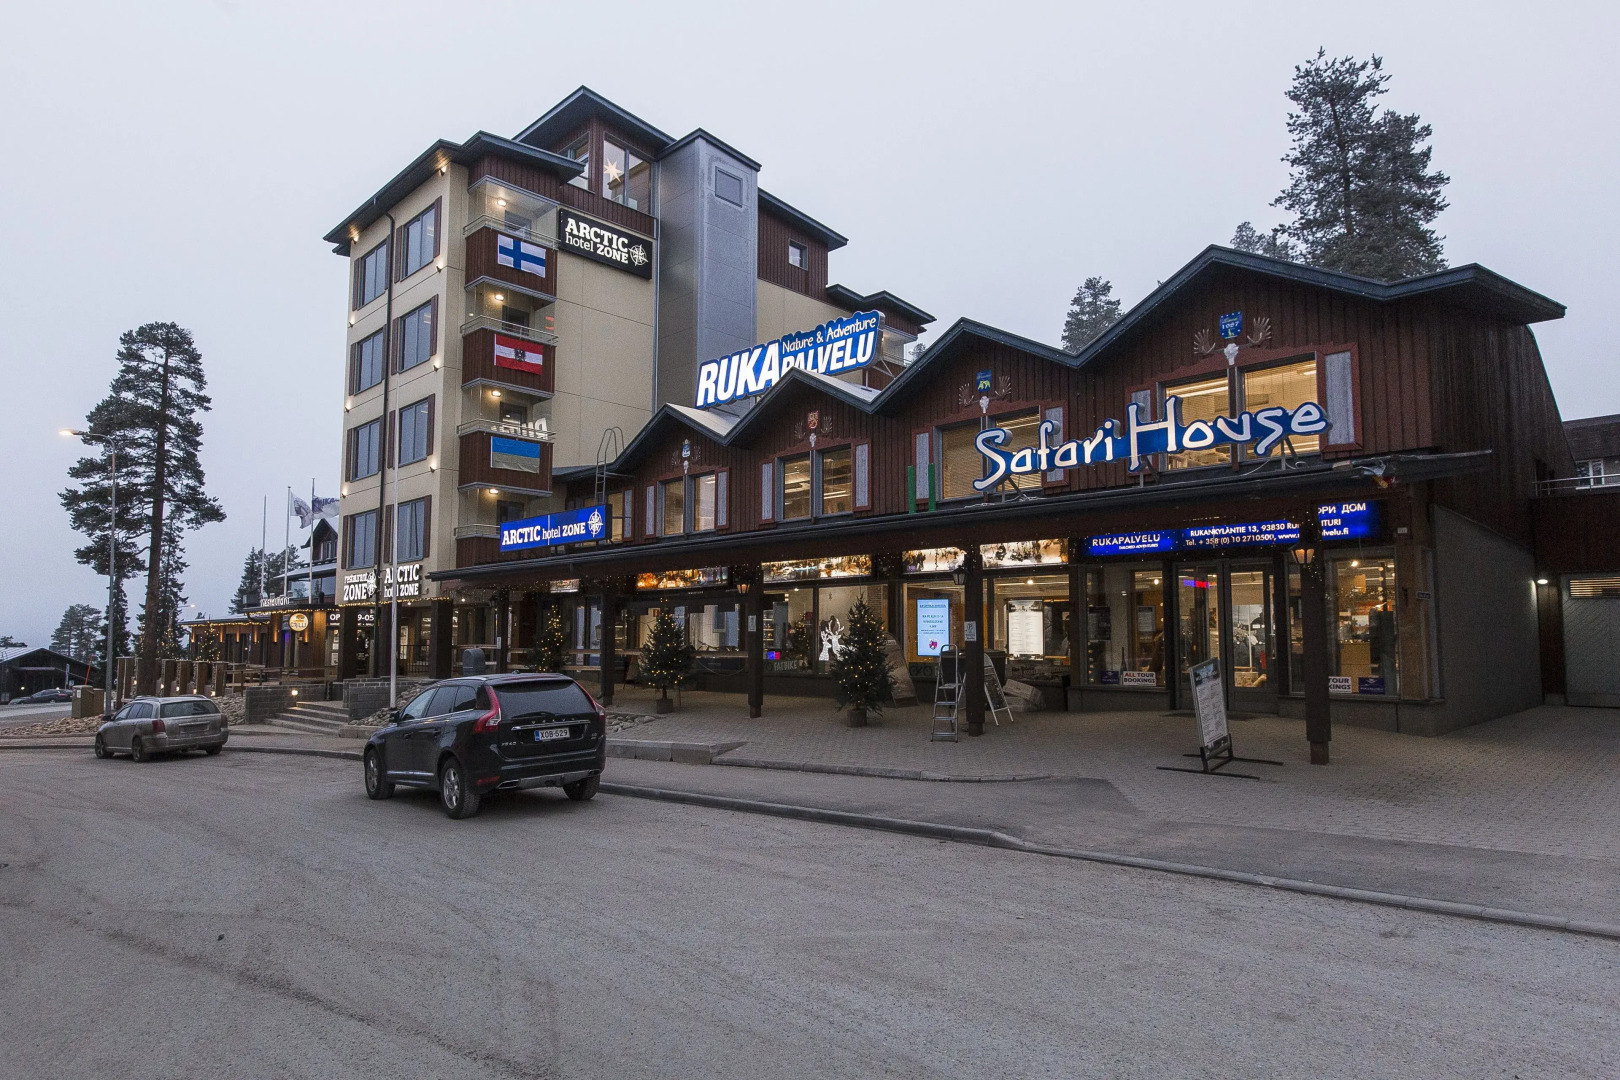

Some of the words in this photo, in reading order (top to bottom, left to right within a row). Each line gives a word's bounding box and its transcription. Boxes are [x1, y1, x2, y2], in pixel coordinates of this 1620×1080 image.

[565, 218, 628, 252] ARCTIC
[565, 232, 594, 252] hotel
[596, 243, 629, 264] ZONE
[782, 336, 814, 354] Nature
[816, 330, 824, 344] &
[826, 317, 877, 342] Adventure
[696, 342, 780, 406] RUKA
[781, 331, 875, 377] PALVELU
[973, 419, 1114, 490] Safari
[1128, 396, 1326, 471] House
[1341, 503, 1366, 514] ДОМ
[502, 525, 541, 546] ARCTIC
[542, 525, 561, 540] hotel
[562, 522, 586, 537] ZONE
[1190, 526, 1246, 537] RUKANKYLÄNTIE
[1248, 525, 1259, 533] 13,
[1261, 523, 1285, 533] 93830
[1220, 536, 1230, 544] (0)
[1242, 534, 1276, 543] 2710500,
[1092, 533, 1161, 547] RUKAPALVELU
[344, 572, 368, 584] restaurant
[384, 564, 420, 584] ACTIC
[343, 583, 368, 601] ZONE
[384, 583, 399, 598] hotl
[400, 583, 419, 597] ZONE
